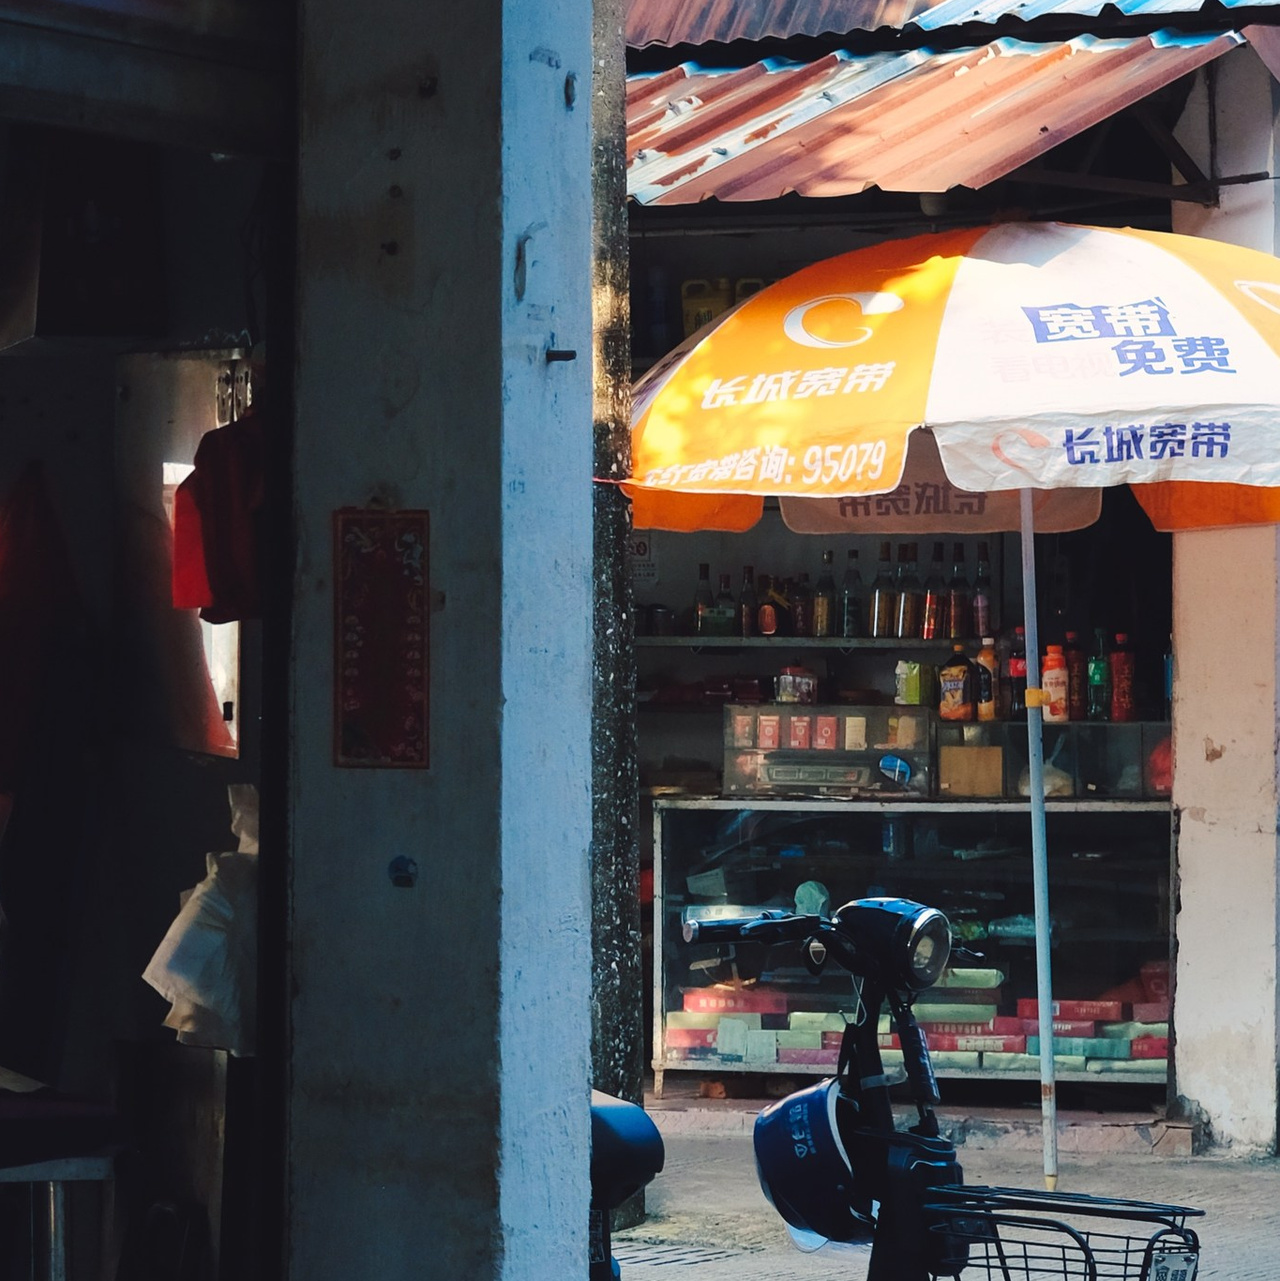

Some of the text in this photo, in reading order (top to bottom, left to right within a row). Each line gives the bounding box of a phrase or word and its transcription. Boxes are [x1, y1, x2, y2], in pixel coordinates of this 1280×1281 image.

[1038, 303, 1163, 339] 宽带
[1111, 336, 1237, 377] 免费
[701, 360, 896, 410] 长城宽带
[802, 439, 886, 485] 95079
[1063, 421, 1231, 465] 长城宽带
